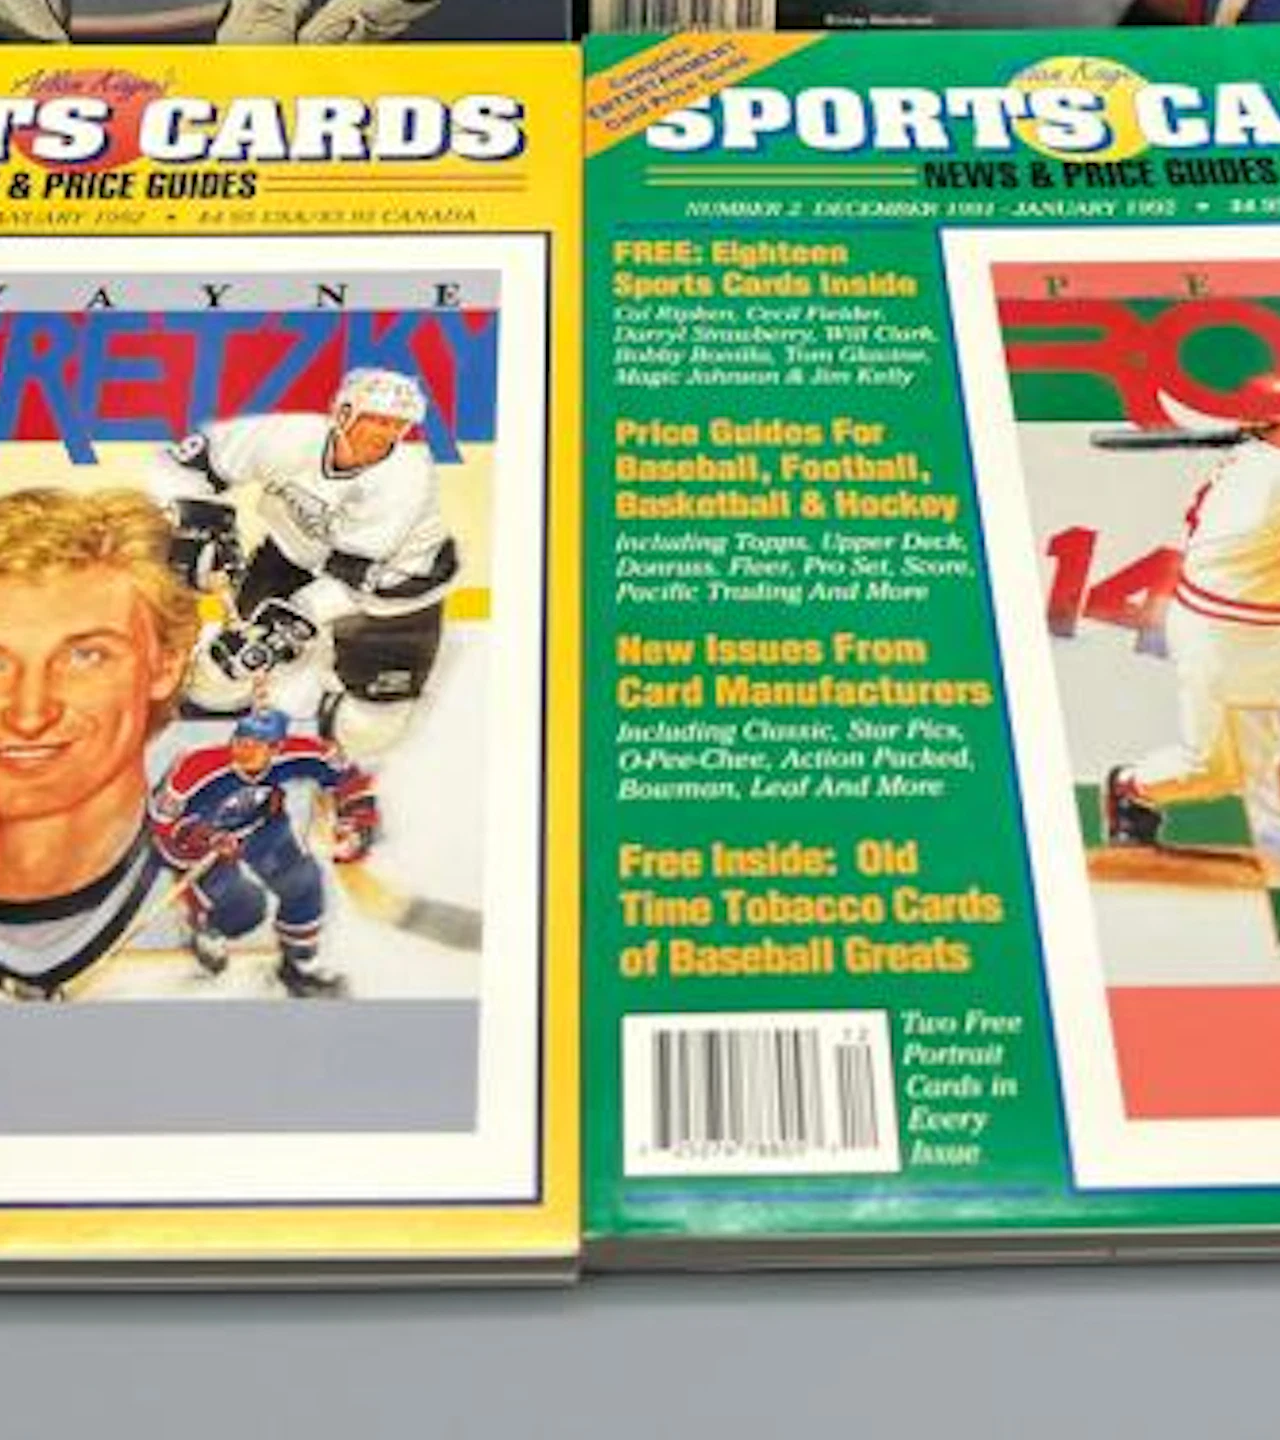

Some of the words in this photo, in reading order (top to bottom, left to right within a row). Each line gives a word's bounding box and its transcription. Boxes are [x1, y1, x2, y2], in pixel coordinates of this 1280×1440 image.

[589, 40, 739, 122] ENTERTAINMENT
[138, 95, 528, 163] CARDS
[645, 86, 1112, 152] SPORTS
[6, 174, 31, 200] &
[43, 172, 136, 200] PRICE
[146, 172, 258, 200] GUIDES
[923, 162, 1018, 190] NEWS
[1030, 162, 1053, 189] &
[1064, 160, 1155, 189] PRICE
[1168, 158, 1280, 186] GUIDES
[684, 201, 782, 218] NUMBER
[811, 201, 937, 218] DECEMBER
[1013, 198, 1117, 218] JANUARY
[613, 240, 703, 264] FREE:
[711, 240, 849, 270] Eighteen
[613, 271, 712, 302] Sports
[722, 272, 811, 297] Cards
[820, 272, 918, 297] Inside
[614, 418, 700, 446] Price
[709, 417, 824, 446] Guides
[830, 417, 885, 446] For
[615, 454, 772, 486] Baseball,
[779, 453, 933, 485] Football,
[615, 491, 791, 519] Basketball
[800, 491, 827, 518] &
[834, 489, 959, 523] Hockey
[616, 532, 729, 556] Including
[822, 532, 896, 556] Upper
[727, 557, 797, 578] Fleer,
[803, 557, 846, 576] Pro
[707, 582, 804, 606] Trading
[808, 582, 860, 601] And
[865, 582, 930, 601] More
[1045, 525, 1184, 660] 14
[616, 633, 696, 665] New
[706, 632, 824, 664] Issues
[831, 631, 928, 664] From
[616, 675, 705, 709] Card
[715, 675, 994, 709] Manufacturers
[616, 719, 737, 745] Including
[847, 719, 901, 740] Star
[618, 747, 773, 772] O-Pee-Chee,
[780, 748, 865, 770] Action
[872, 747, 975, 772] Packed,
[617, 777, 742, 801] Bowman,
[749, 776, 809, 798] Leaf
[816, 774, 870, 798] And
[876, 774, 947, 798] More
[619, 843, 703, 879] Free
[711, 842, 838, 877] Inside:
[856, 840, 919, 875] Old
[619, 889, 711, 927] Time
[720, 889, 885, 926] Tobacco
[893, 885, 1004, 924] Cards
[620, 940, 661, 978] of
[669, 937, 834, 976] Baseball
[844, 936, 972, 973] Greats
[900, 1010, 958, 1035] Two
[964, 1010, 1022, 1034] Free
[903, 1044, 1004, 1067] Portrait
[905, 1075, 983, 1098] Cards
[992, 1075, 1019, 1097] in
[908, 1106, 989, 1134] Every
[910, 1140, 981, 1166] Issue
